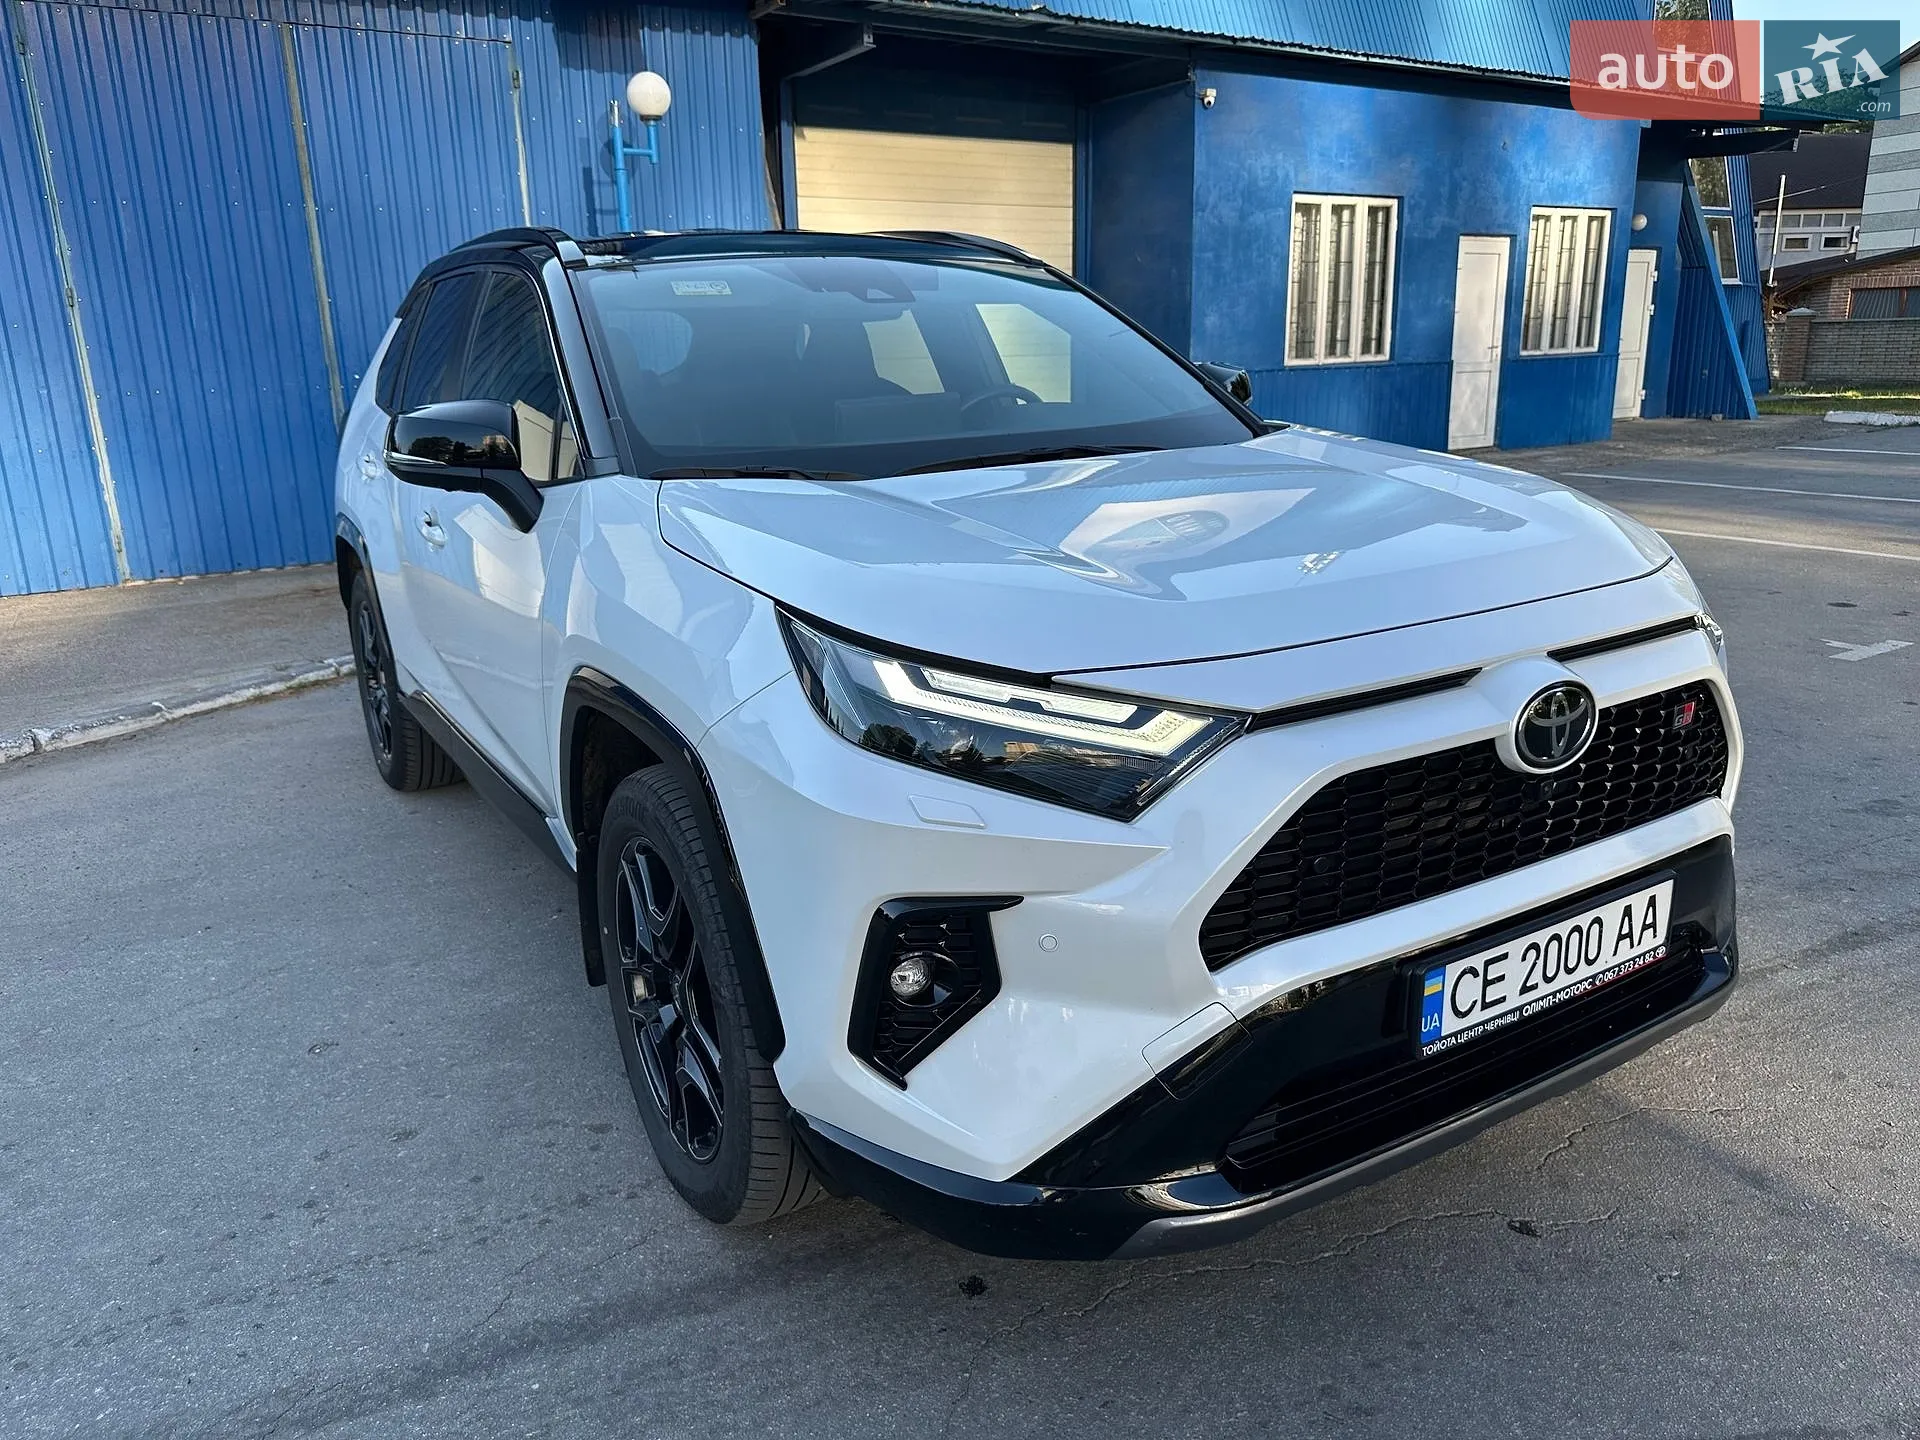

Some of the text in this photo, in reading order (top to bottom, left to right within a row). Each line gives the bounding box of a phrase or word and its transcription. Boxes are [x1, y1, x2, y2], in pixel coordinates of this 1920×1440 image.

[1422, 951, 1655, 1057] ТОЙОТА ЦЕНТР ЧЕРНІВЦІ ОЛІМП-МОТОРС 067 373 24 82
[1450, 894, 1658, 1019] CE 2000 AA
[1421, 1012, 1441, 1033] UA
